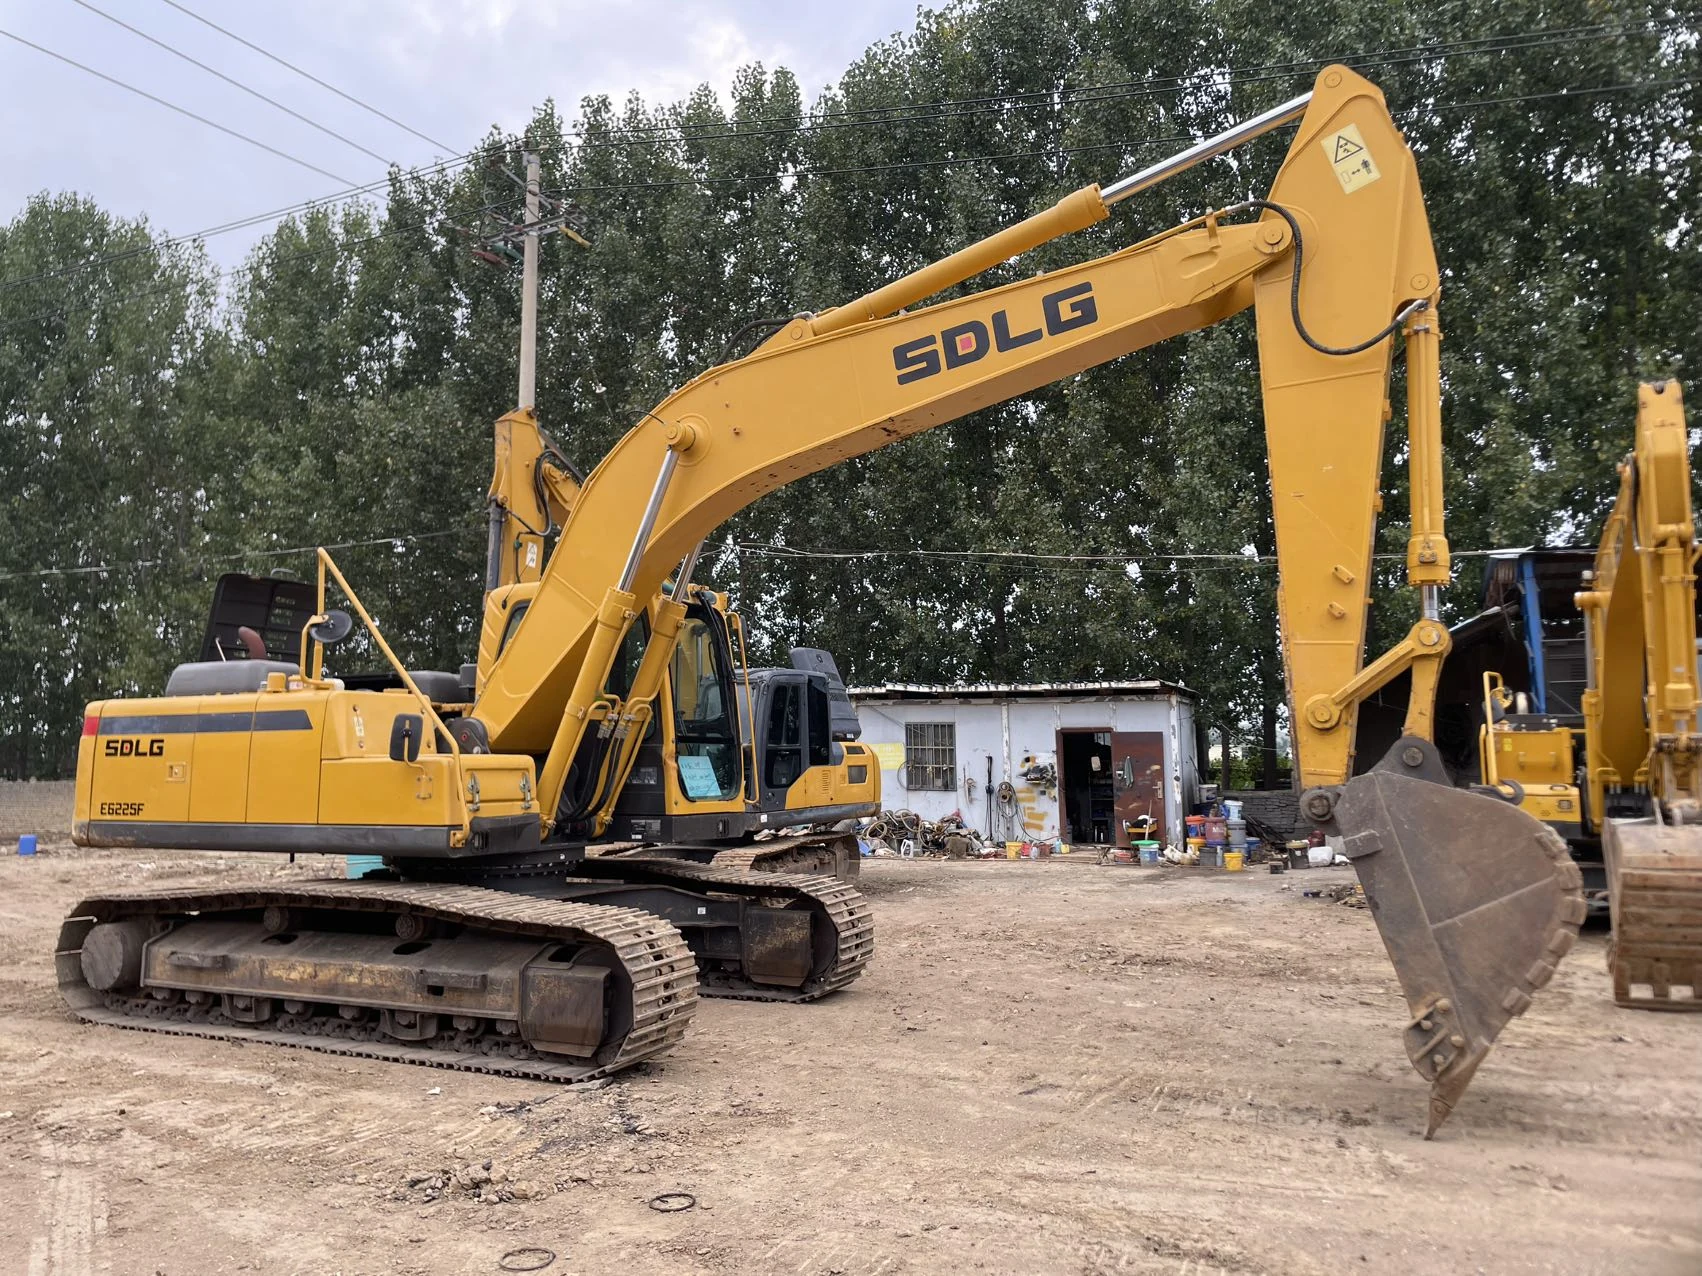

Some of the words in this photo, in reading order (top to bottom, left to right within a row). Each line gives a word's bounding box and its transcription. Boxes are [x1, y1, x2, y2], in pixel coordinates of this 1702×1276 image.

[892, 281, 1099, 386] SDLG
[105, 739, 165, 757] SDLG
[100, 802, 145, 816] E6225F
